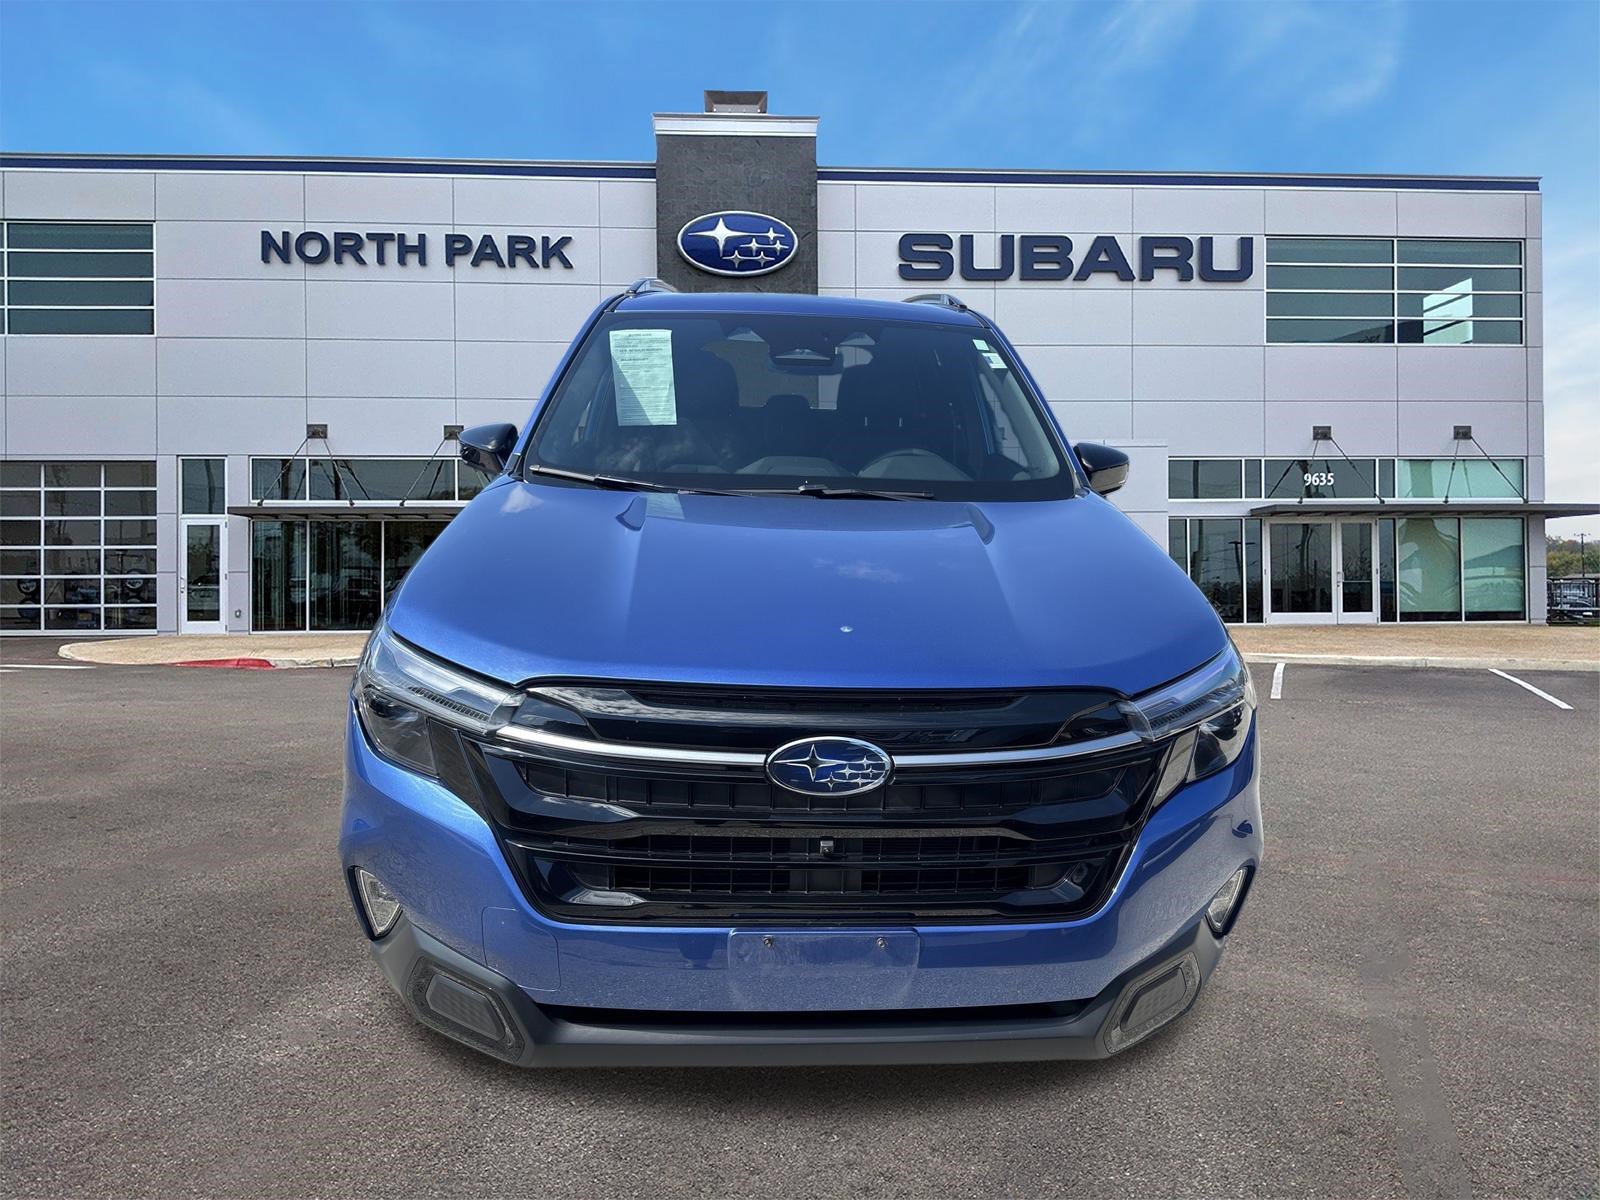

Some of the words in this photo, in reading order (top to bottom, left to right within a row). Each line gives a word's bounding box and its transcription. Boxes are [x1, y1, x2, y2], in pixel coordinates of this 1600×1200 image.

[261, 230, 428, 266] NORTH
[445, 233, 574, 269] PARK
[898, 233, 1254, 282] SUBARU
[1303, 472, 1335, 486] 9635
